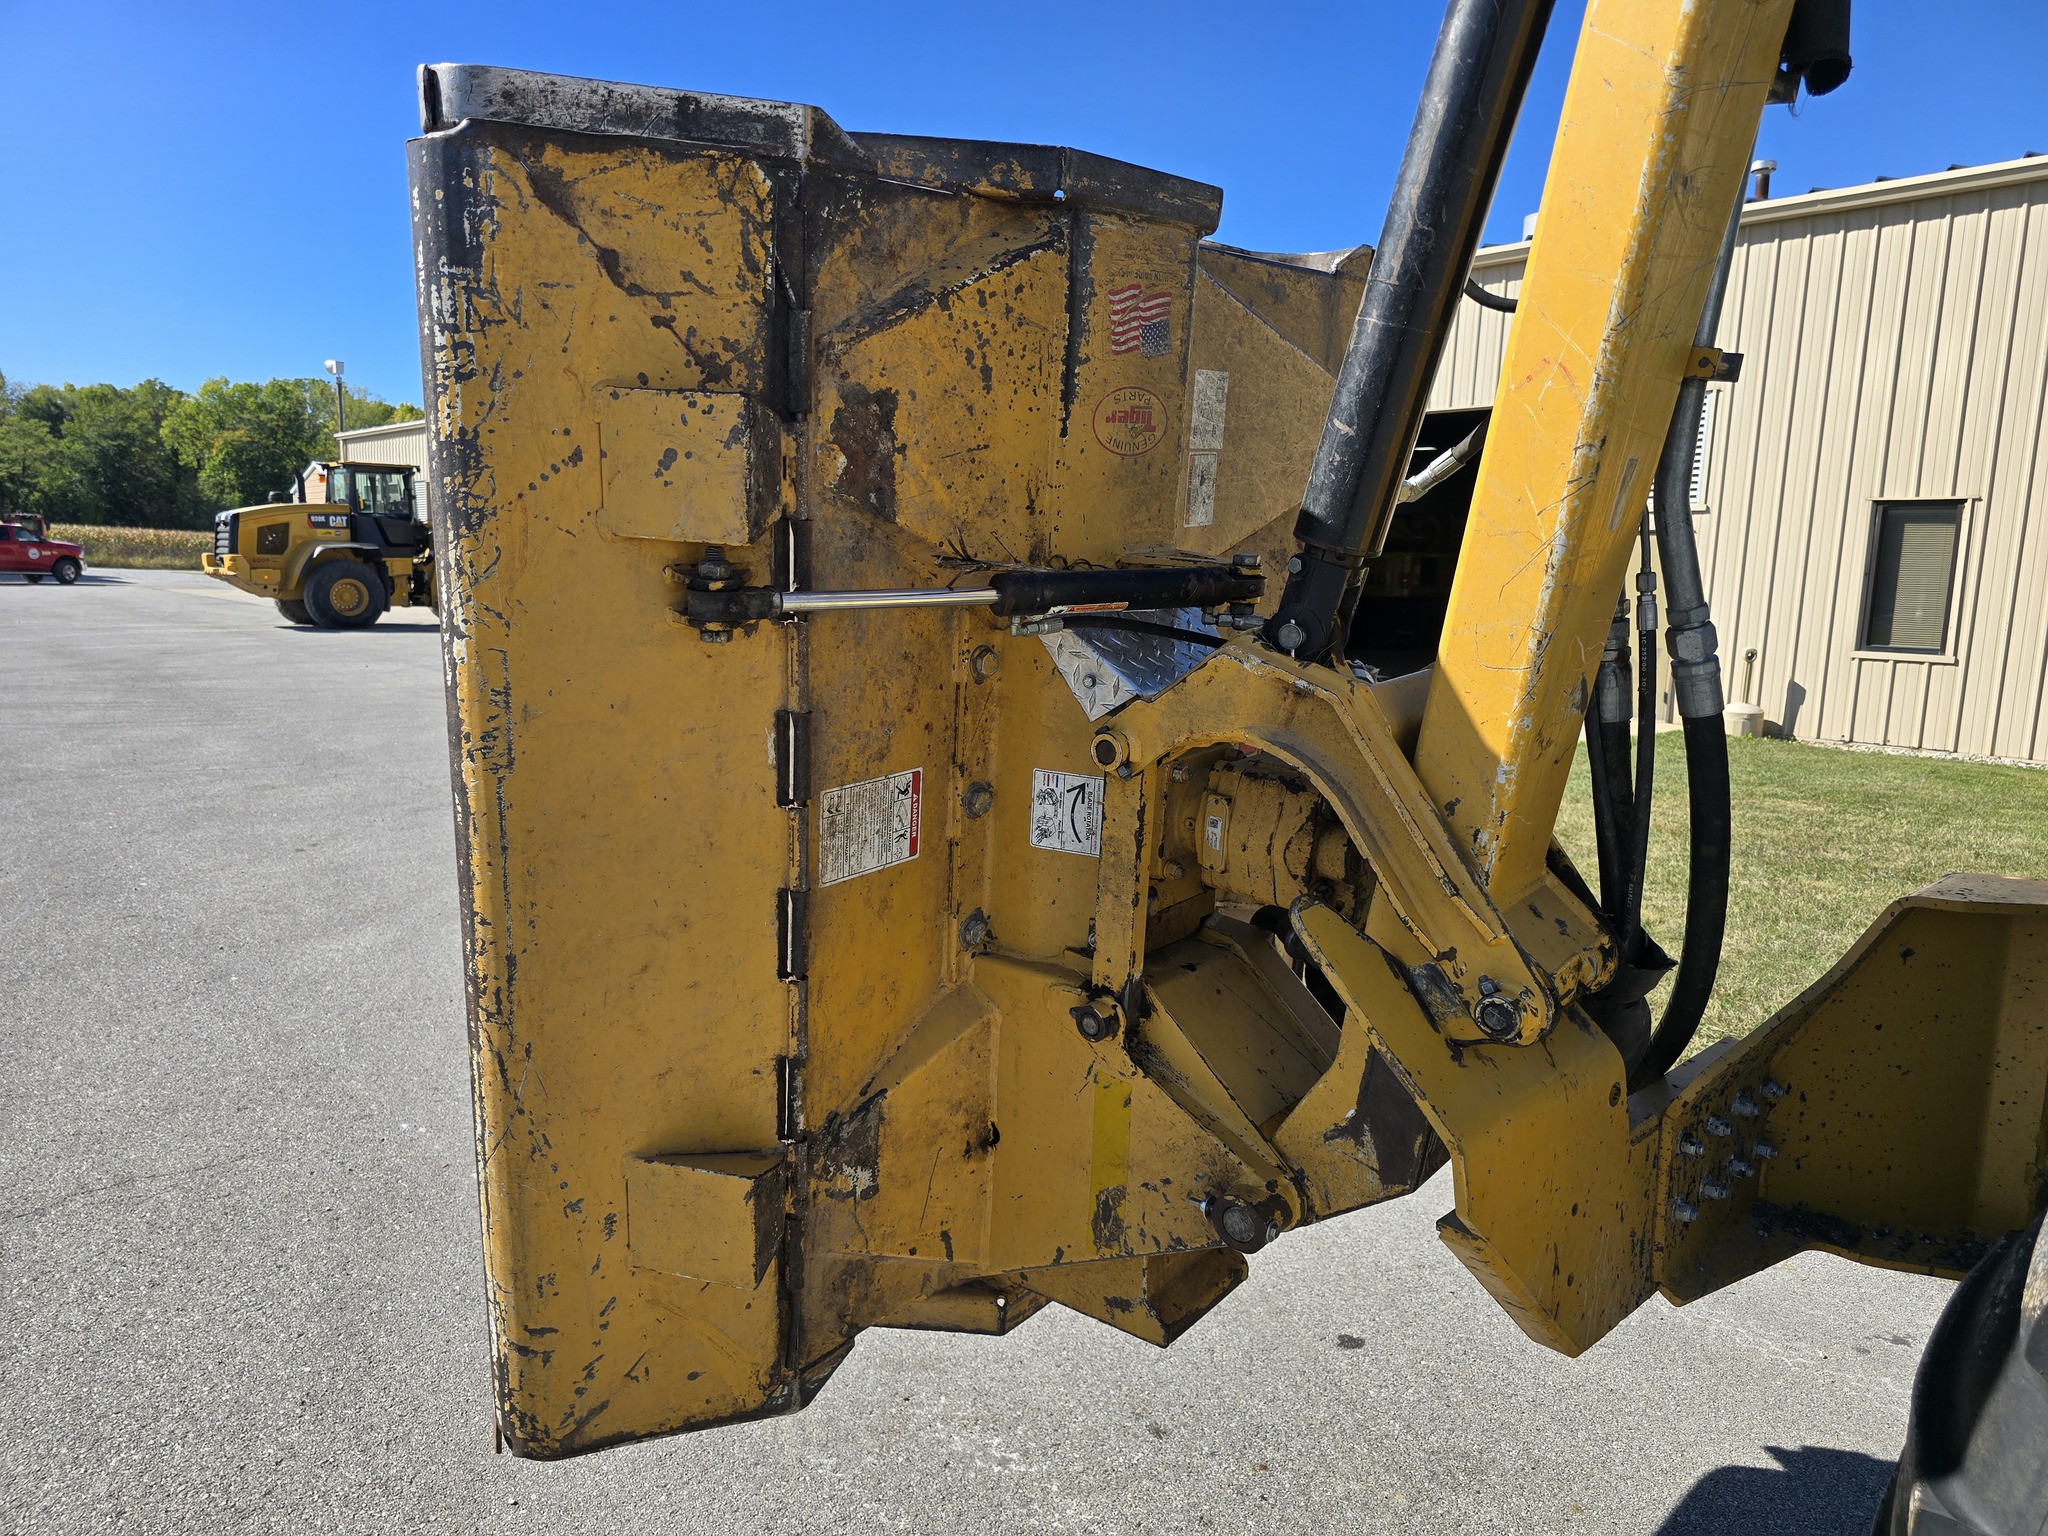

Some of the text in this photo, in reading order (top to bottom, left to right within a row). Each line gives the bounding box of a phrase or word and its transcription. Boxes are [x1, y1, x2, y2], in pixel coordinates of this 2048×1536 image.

[1114, 391, 1151, 406] PARTS
[1106, 406, 1156, 432] Tiger
[1105, 432, 1156, 451] GENUINE
[329, 515, 347, 528] CAT
